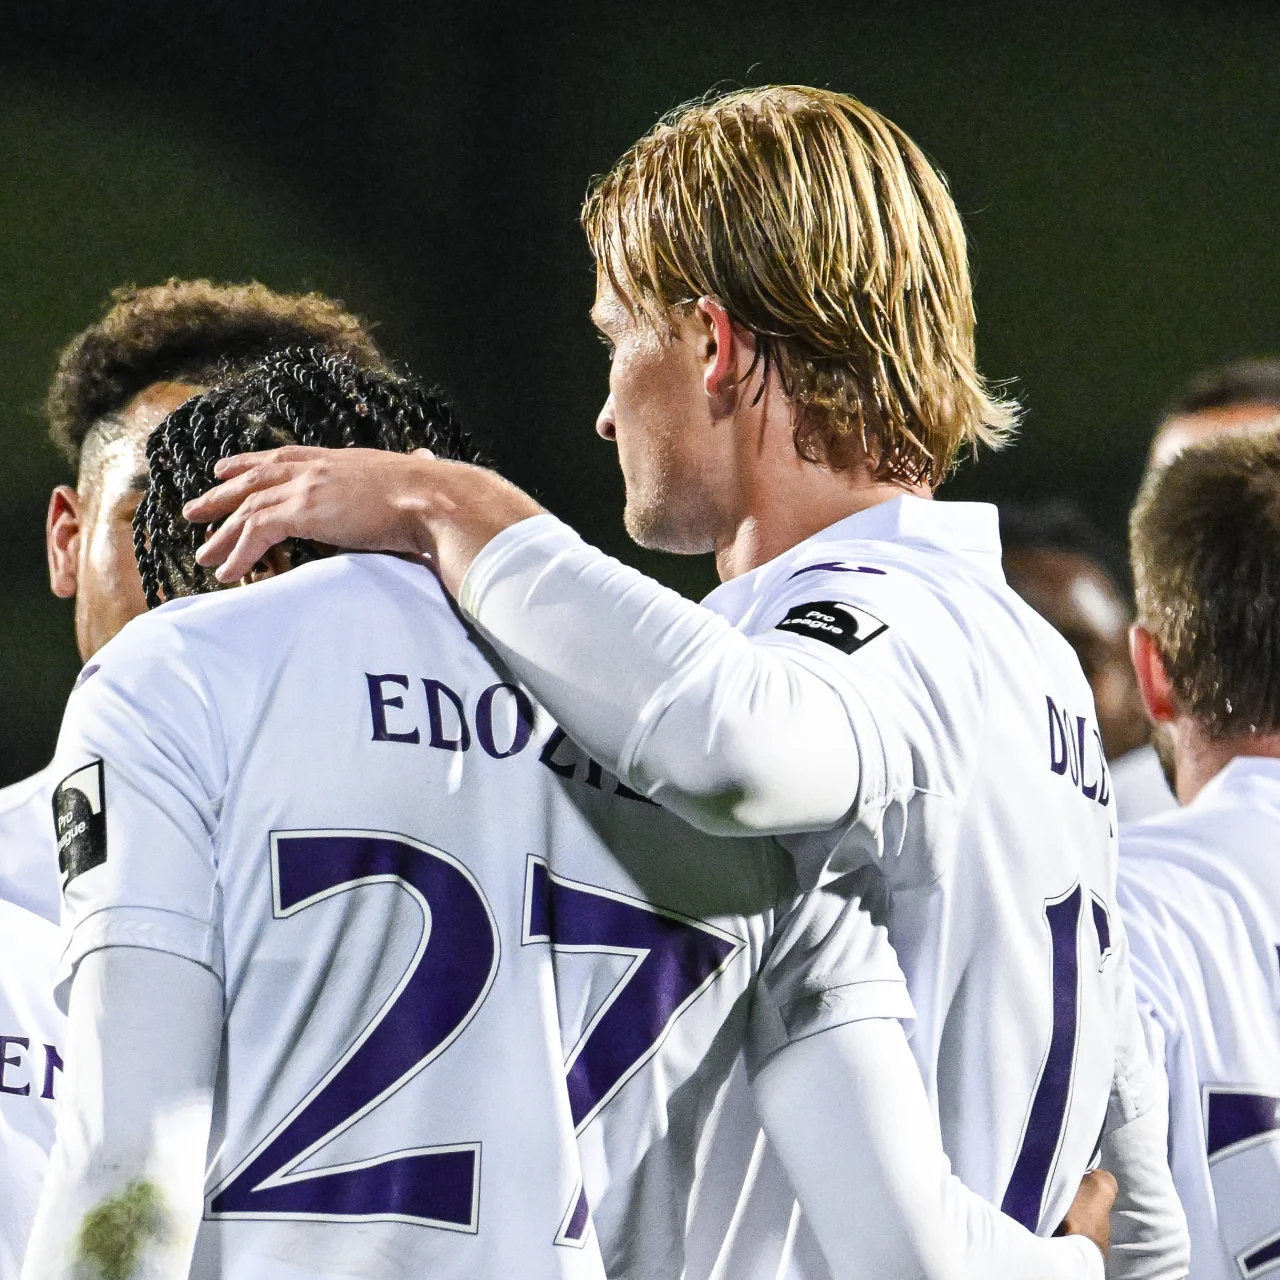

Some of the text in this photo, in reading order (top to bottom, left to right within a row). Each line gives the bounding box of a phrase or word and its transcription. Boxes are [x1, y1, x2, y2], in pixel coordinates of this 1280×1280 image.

[782, 618, 843, 634] League
[806, 610, 836, 622] Pro
[365, 672, 662, 807] EDOZ
[58, 811, 73, 833] Pro
[58, 821, 86, 852] ague
[203, 829, 748, 1249] 27
